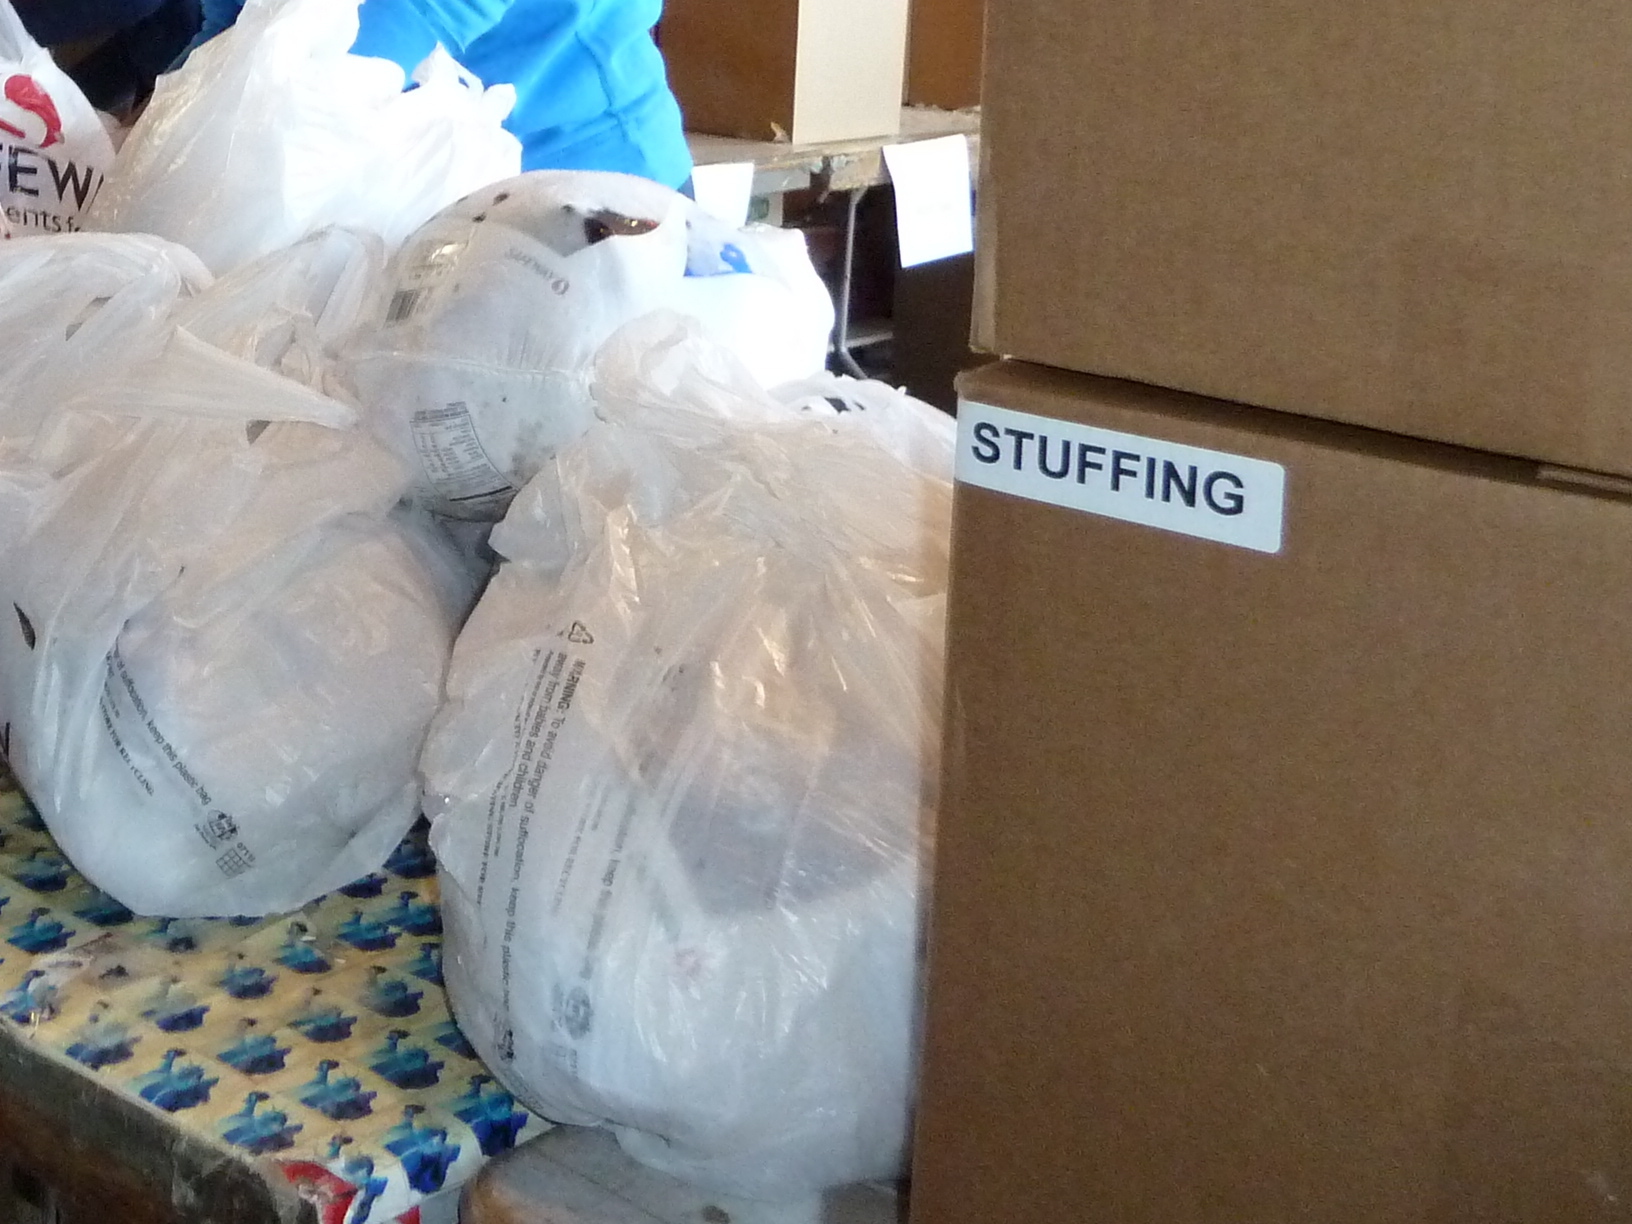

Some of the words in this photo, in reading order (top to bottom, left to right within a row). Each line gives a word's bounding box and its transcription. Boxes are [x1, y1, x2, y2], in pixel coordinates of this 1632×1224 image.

[971, 421, 1245, 516] STUFFING
[520, 737, 537, 762] and
[540, 730, 558, 761] avoid
[146, 718, 165, 745] keep
[161, 741, 179, 763] this
[195, 784, 213, 806] bag
[527, 759, 549, 800] danger
[523, 799, 535, 814] of
[503, 918, 517, 943] this
